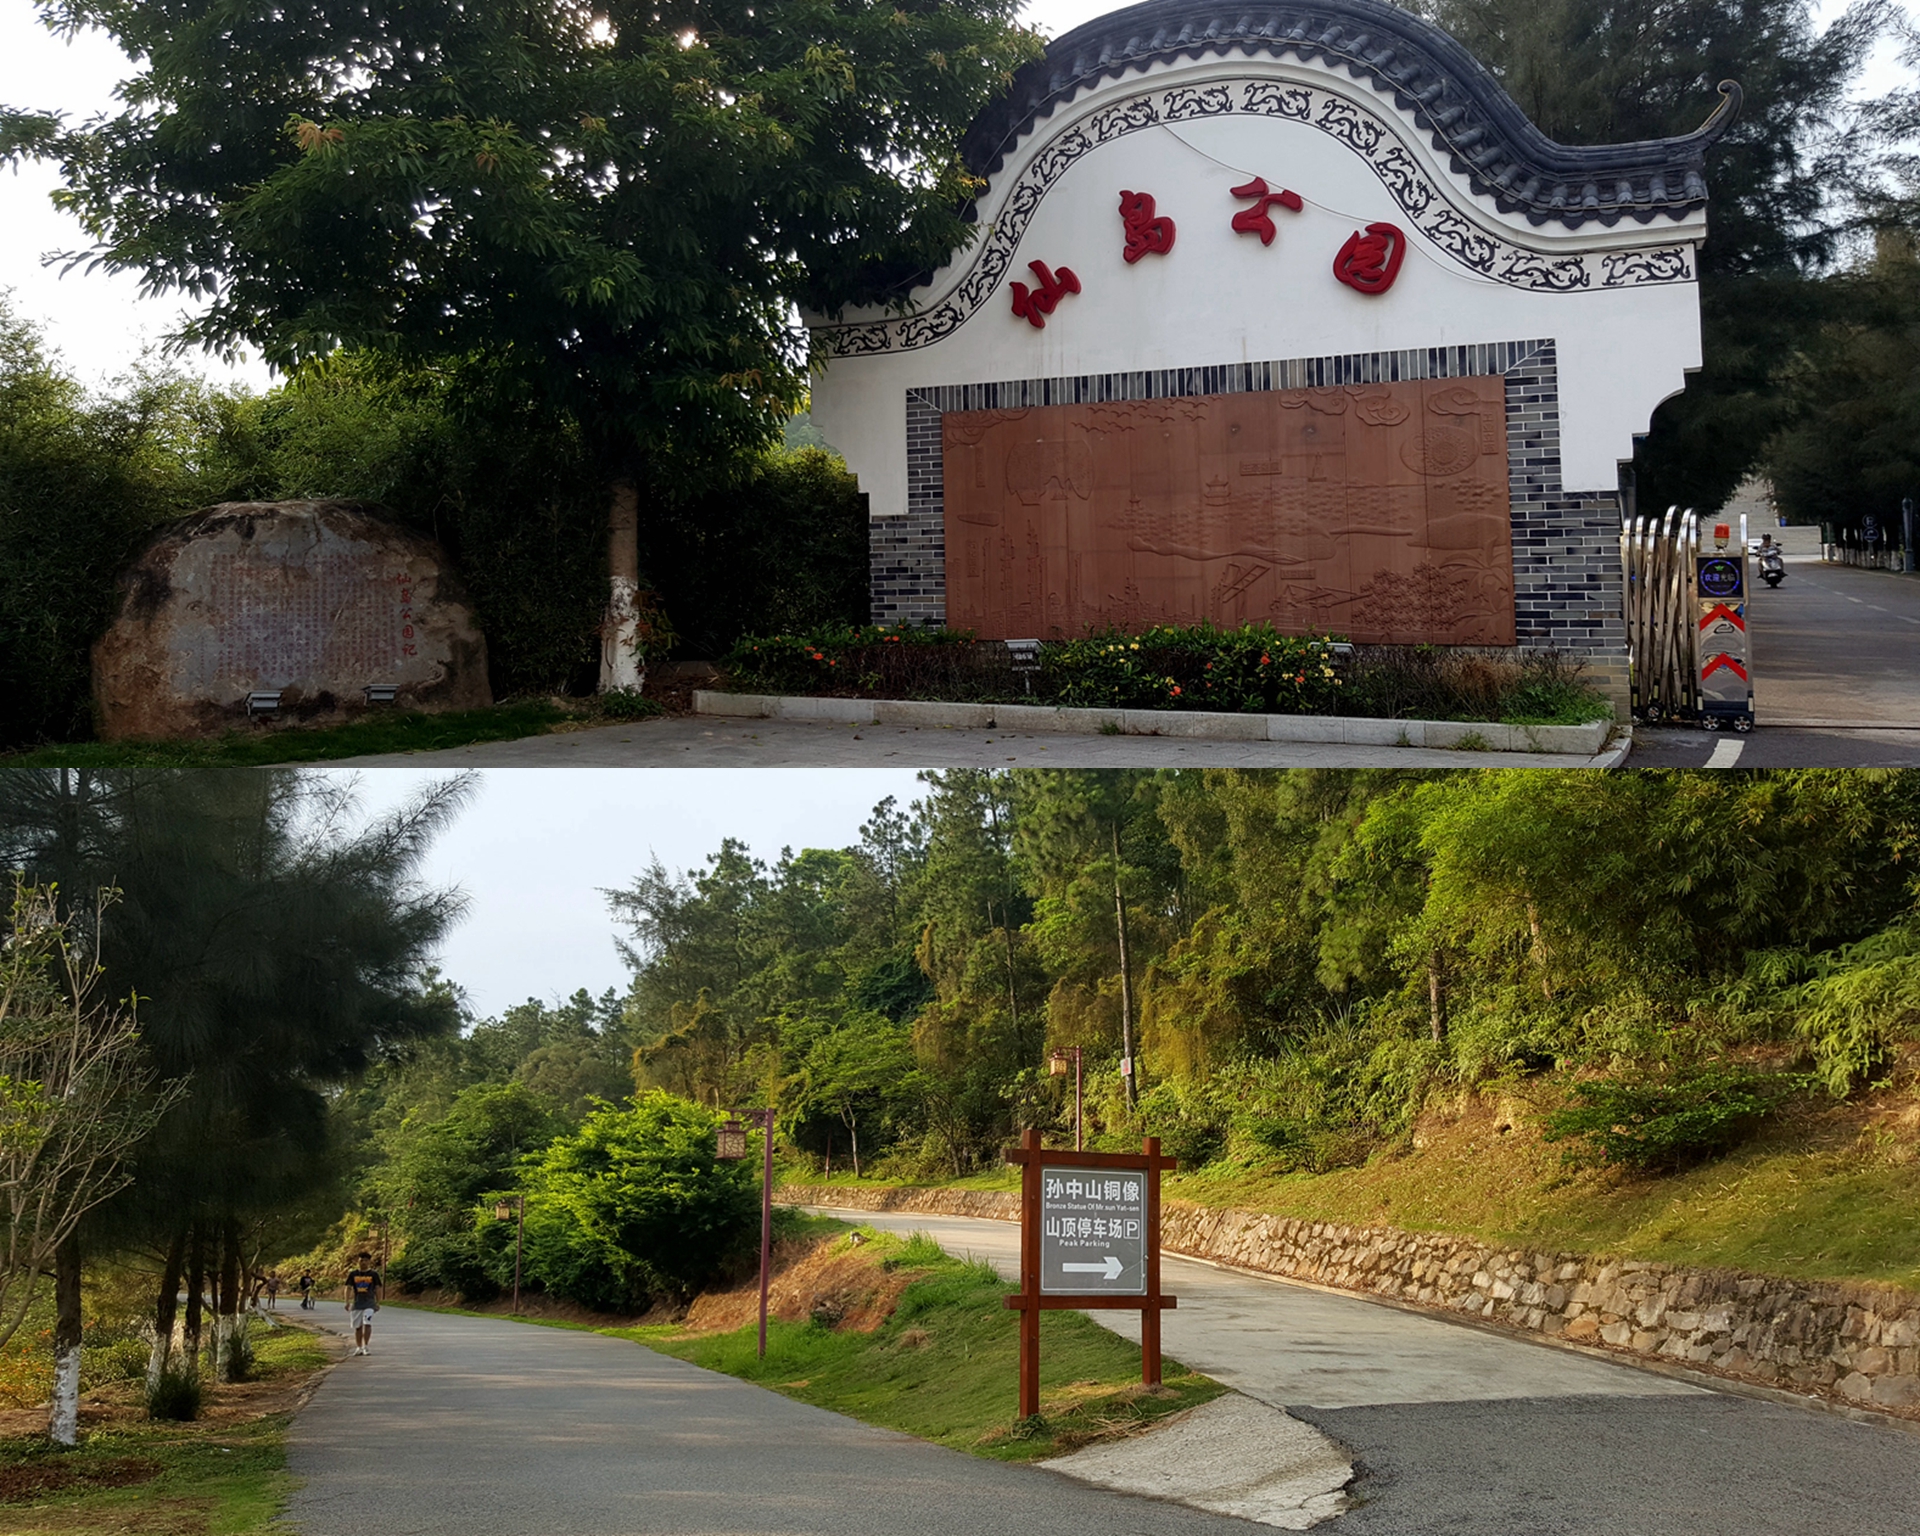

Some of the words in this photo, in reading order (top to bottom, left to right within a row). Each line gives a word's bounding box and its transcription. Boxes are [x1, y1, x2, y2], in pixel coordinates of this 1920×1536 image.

[1009, 176, 1407, 329] 仙岛公园
[1045, 1178, 1140, 1202] 孙中山铜像
[1045, 1202, 1067, 1210] Bronze
[1067, 1202, 1087, 1210] Statue
[1087, 1202, 1095, 1210] Of
[1116, 1204, 1140, 1212] Yat-sen
[1046, 1217, 1123, 1239] 山顶停车场
[1059, 1239, 1078, 1247] Peak
[1080, 1239, 1110, 1249] Parking
